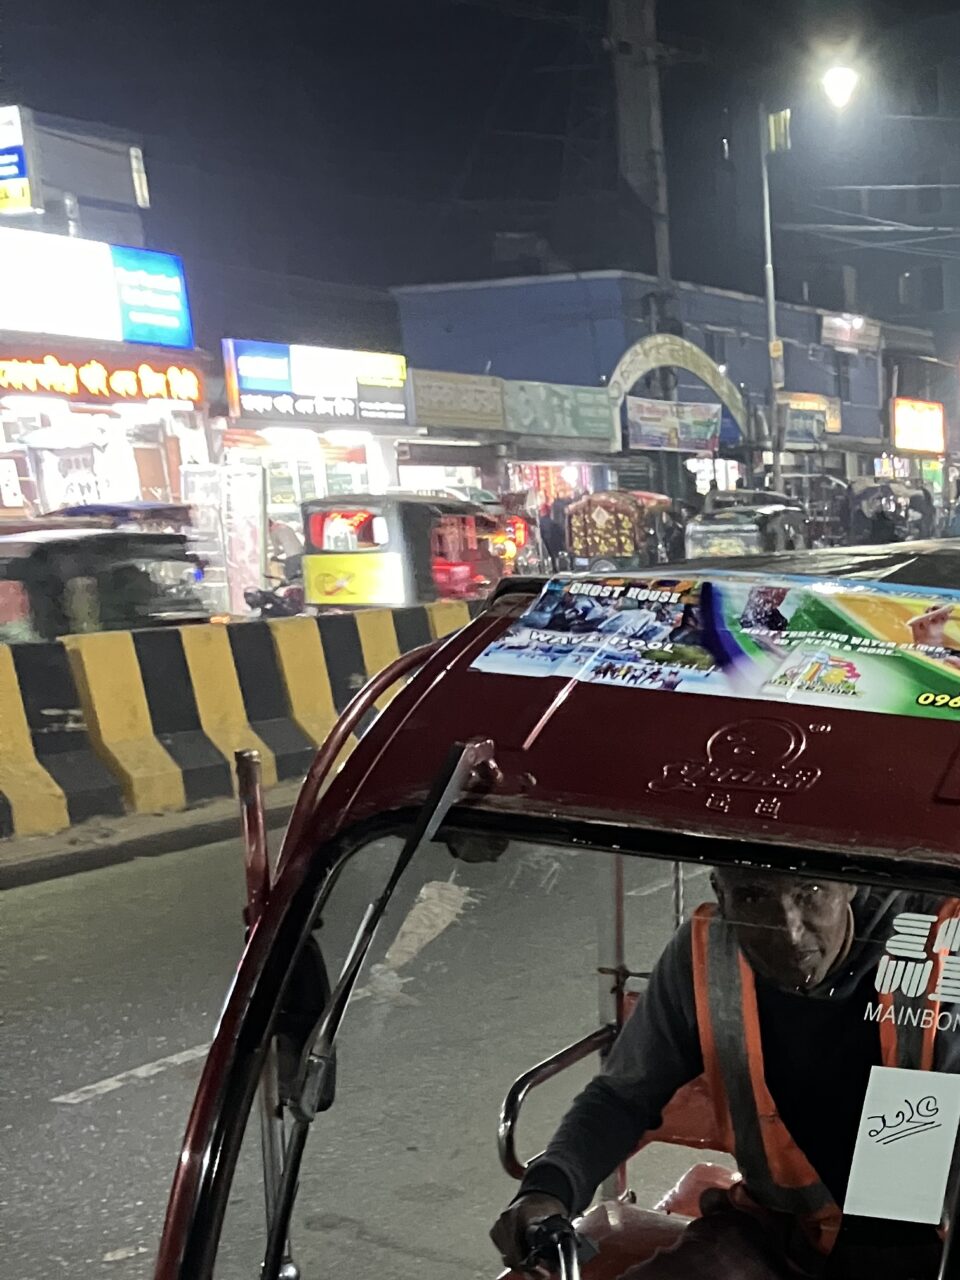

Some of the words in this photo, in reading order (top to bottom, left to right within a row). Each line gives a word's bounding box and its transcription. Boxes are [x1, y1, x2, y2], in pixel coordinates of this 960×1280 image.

[569, 582, 625, 598] GHOST
[626, 587, 682, 604] HOUSE
[609, 637, 674, 654] POOL
